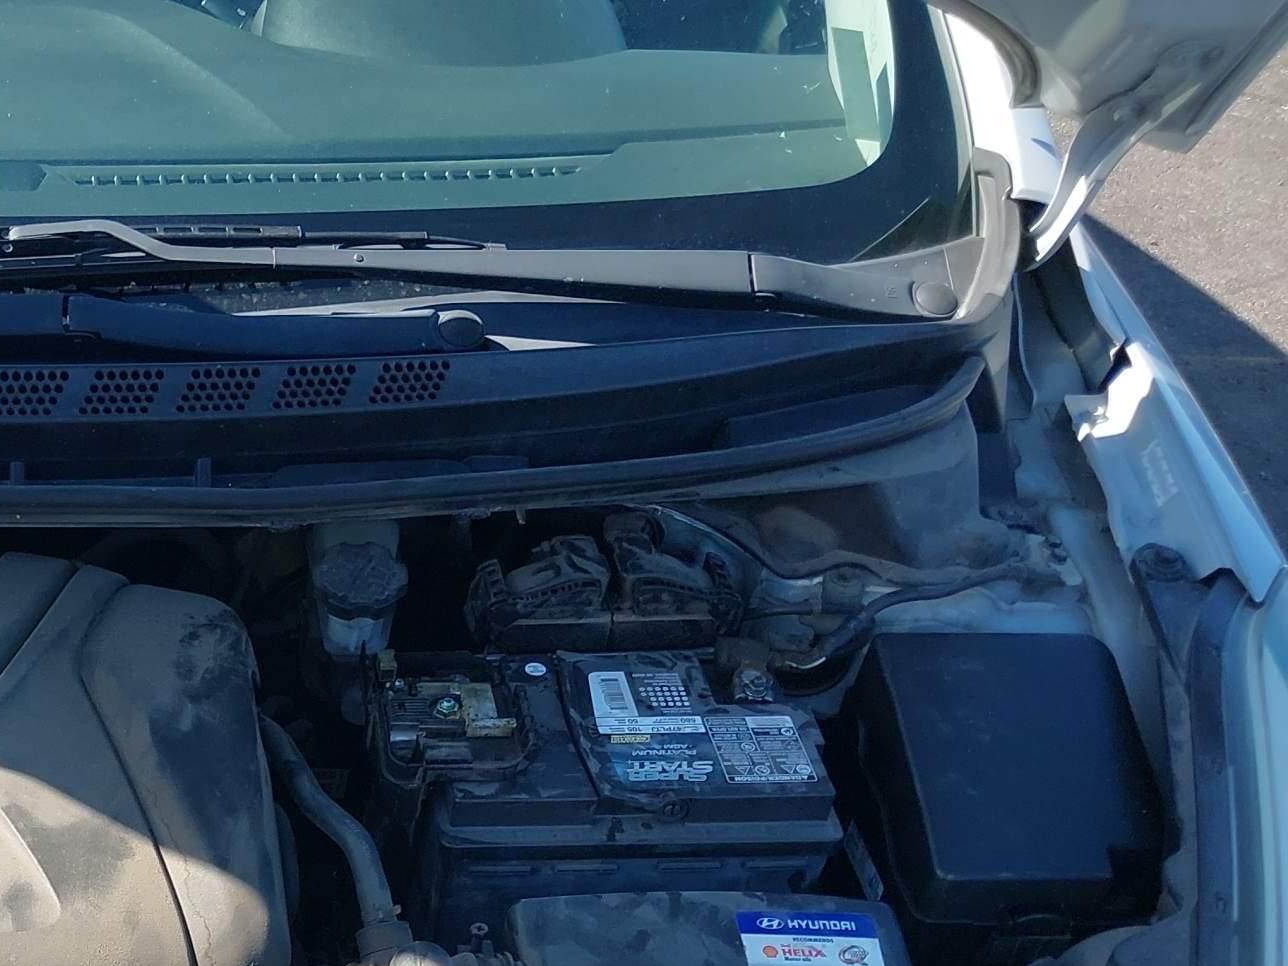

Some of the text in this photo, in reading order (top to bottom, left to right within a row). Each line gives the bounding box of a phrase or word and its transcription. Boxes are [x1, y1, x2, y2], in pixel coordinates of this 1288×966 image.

[631, 749, 697, 757] PLATINUM
[626, 760, 714, 774] START
[628, 770, 707, 782] SUPER
[787, 919, 857, 931] HYUNDAI
[781, 948, 824, 958] HELIX
